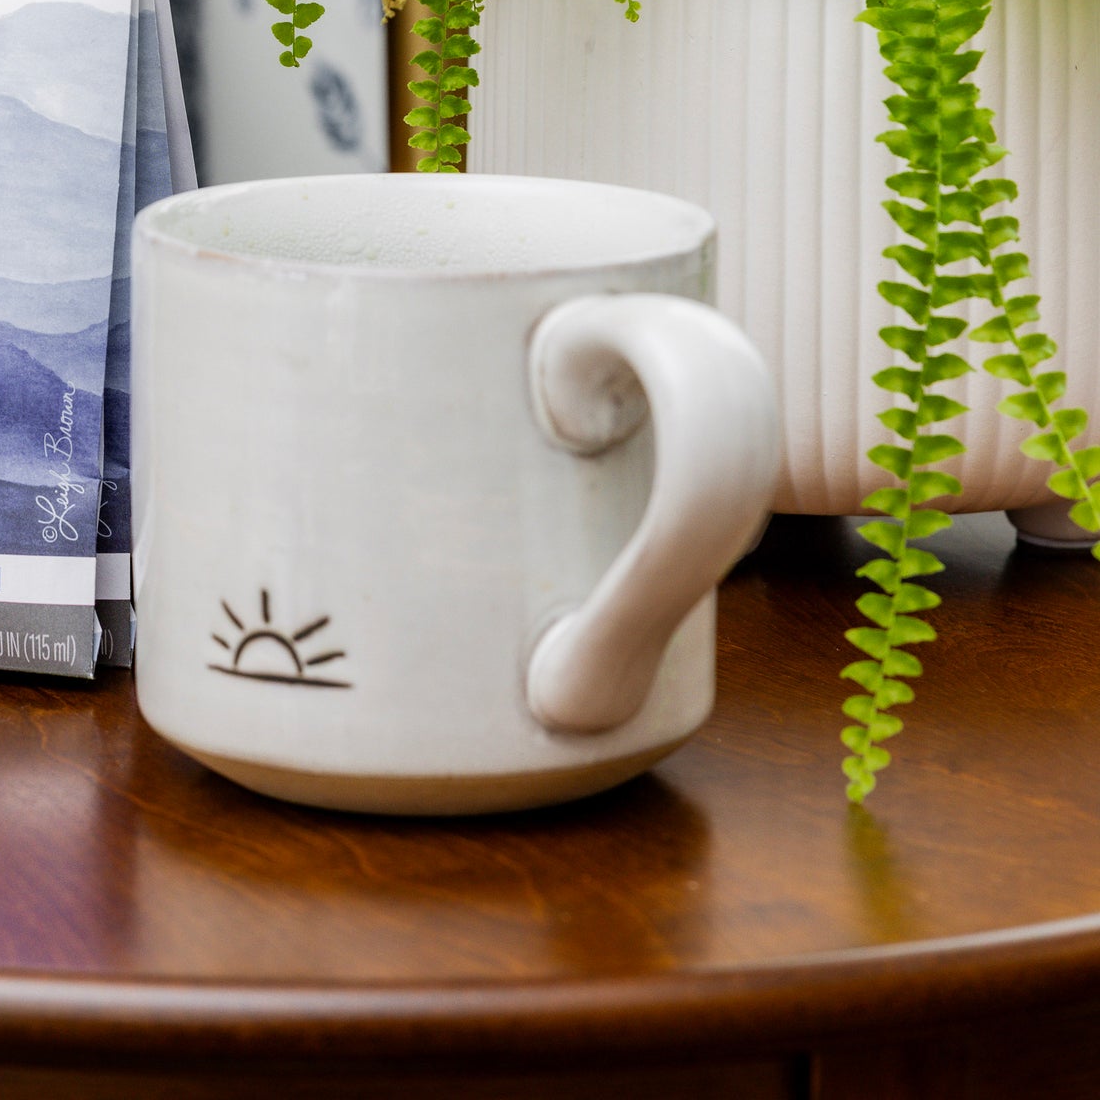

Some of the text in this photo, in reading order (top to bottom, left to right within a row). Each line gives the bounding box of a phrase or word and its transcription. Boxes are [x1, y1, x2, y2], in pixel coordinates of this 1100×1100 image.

[43, 380, 76, 462] Brown
[7, 631, 20, 658] IN
[23, 632, 50, 662] (115
[53, 635, 76, 666] ml)
